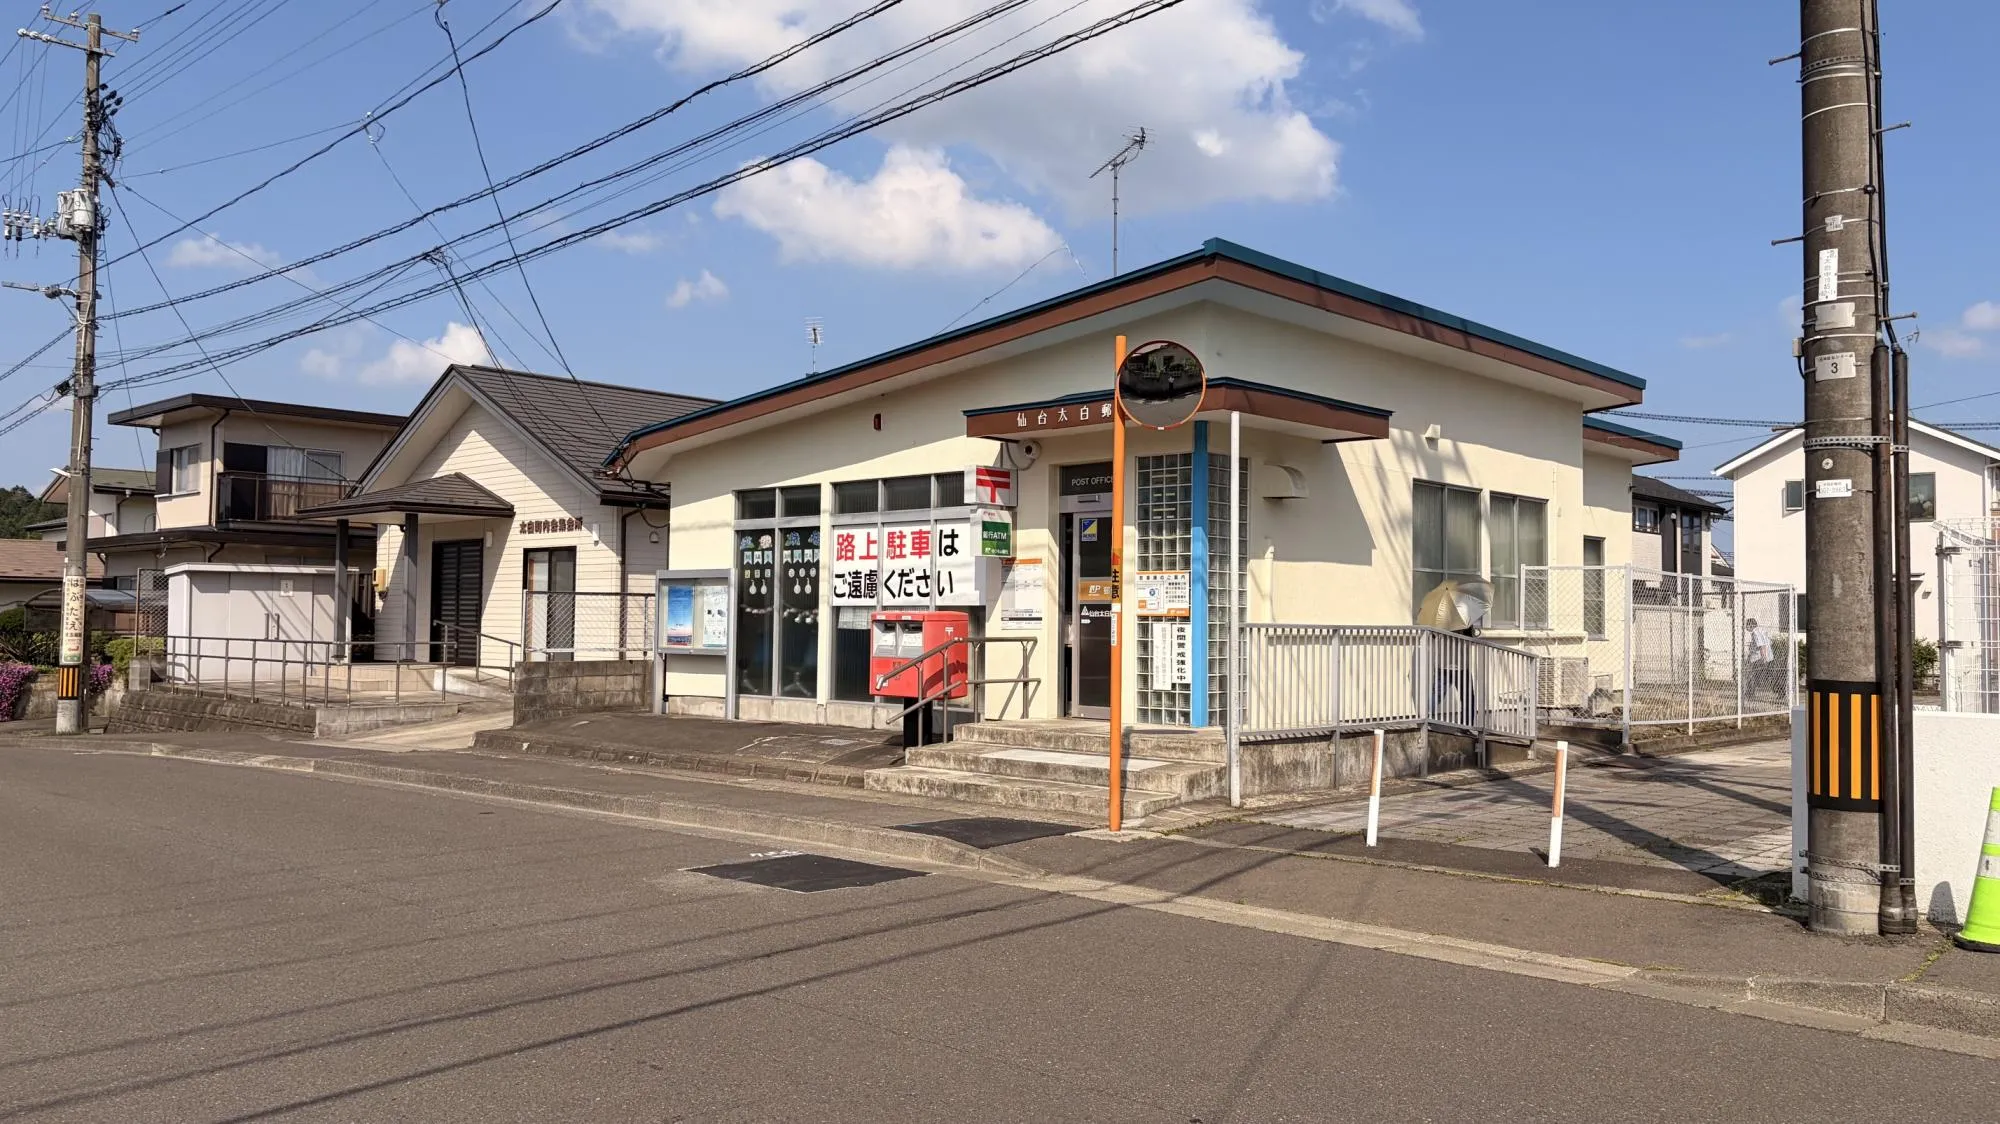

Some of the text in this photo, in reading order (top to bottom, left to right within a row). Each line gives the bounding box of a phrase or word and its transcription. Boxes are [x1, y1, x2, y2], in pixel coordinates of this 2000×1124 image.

[1831, 362, 1839, 374] 3
[1016, 403, 1112, 427] 仙台太白郵
[1071, 475, 1113, 487] POST OFFIC
[836, 528, 960, 562] 路上駐車は
[833, 567, 954, 600] ご遠慮ください
[1089, 609, 1112, 618] 仙台太白
